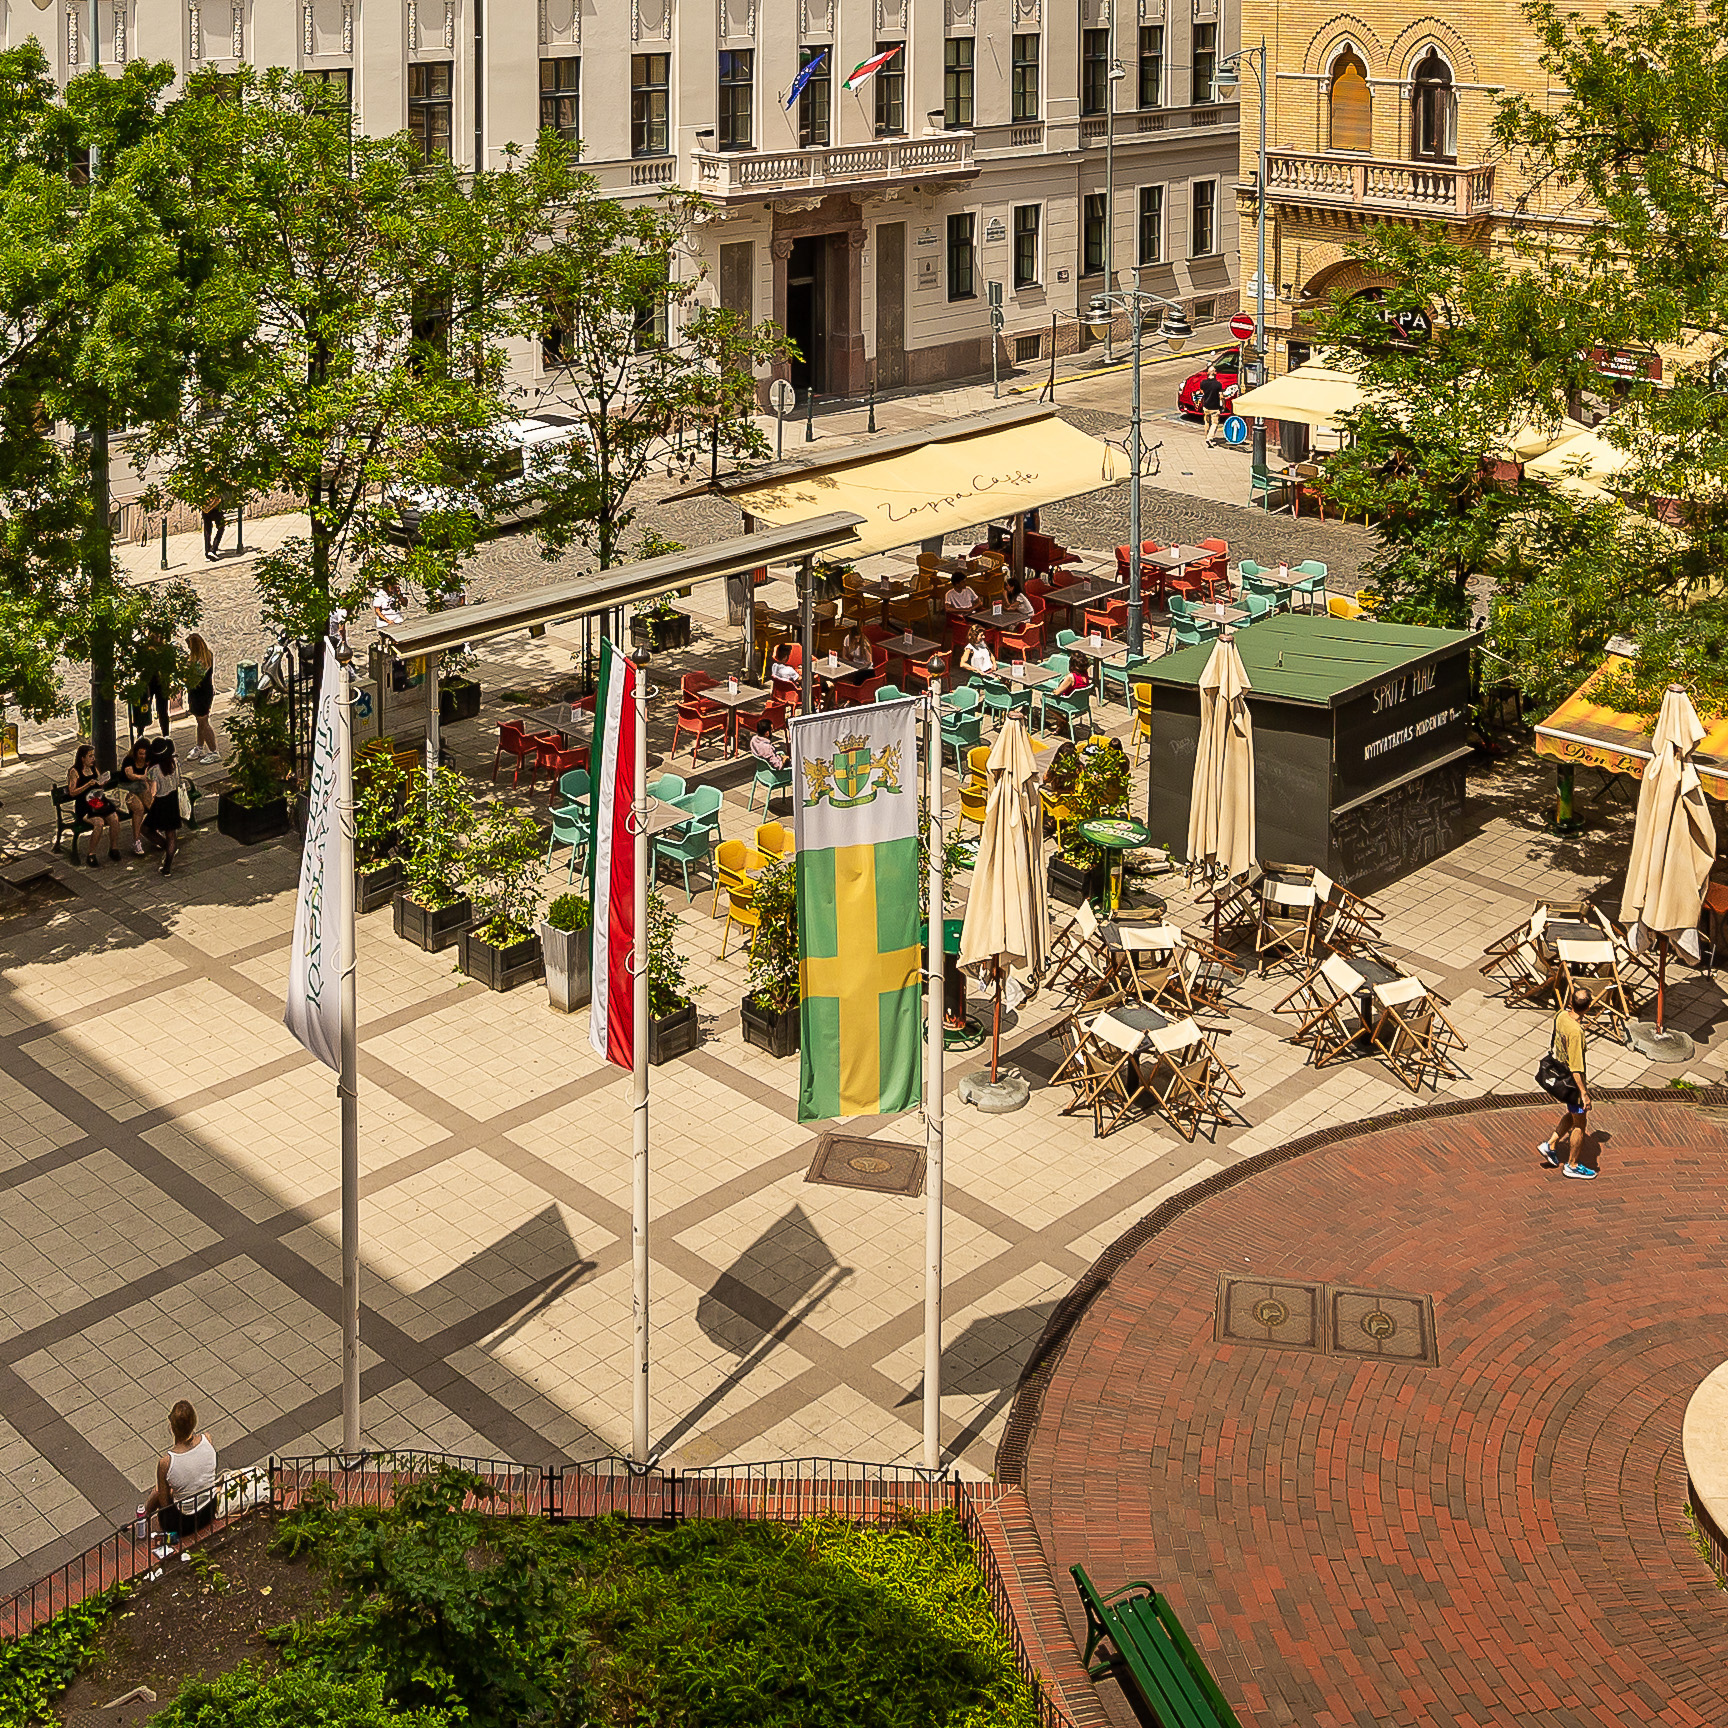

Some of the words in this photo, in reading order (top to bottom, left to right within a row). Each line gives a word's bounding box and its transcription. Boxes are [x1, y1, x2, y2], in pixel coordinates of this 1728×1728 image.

[877, 493, 972, 521] Zappa
[1373, 675, 1406, 714] SPRITZ
[1564, 743, 1605, 765] Don
[1611, 755, 1642, 773] Leo
